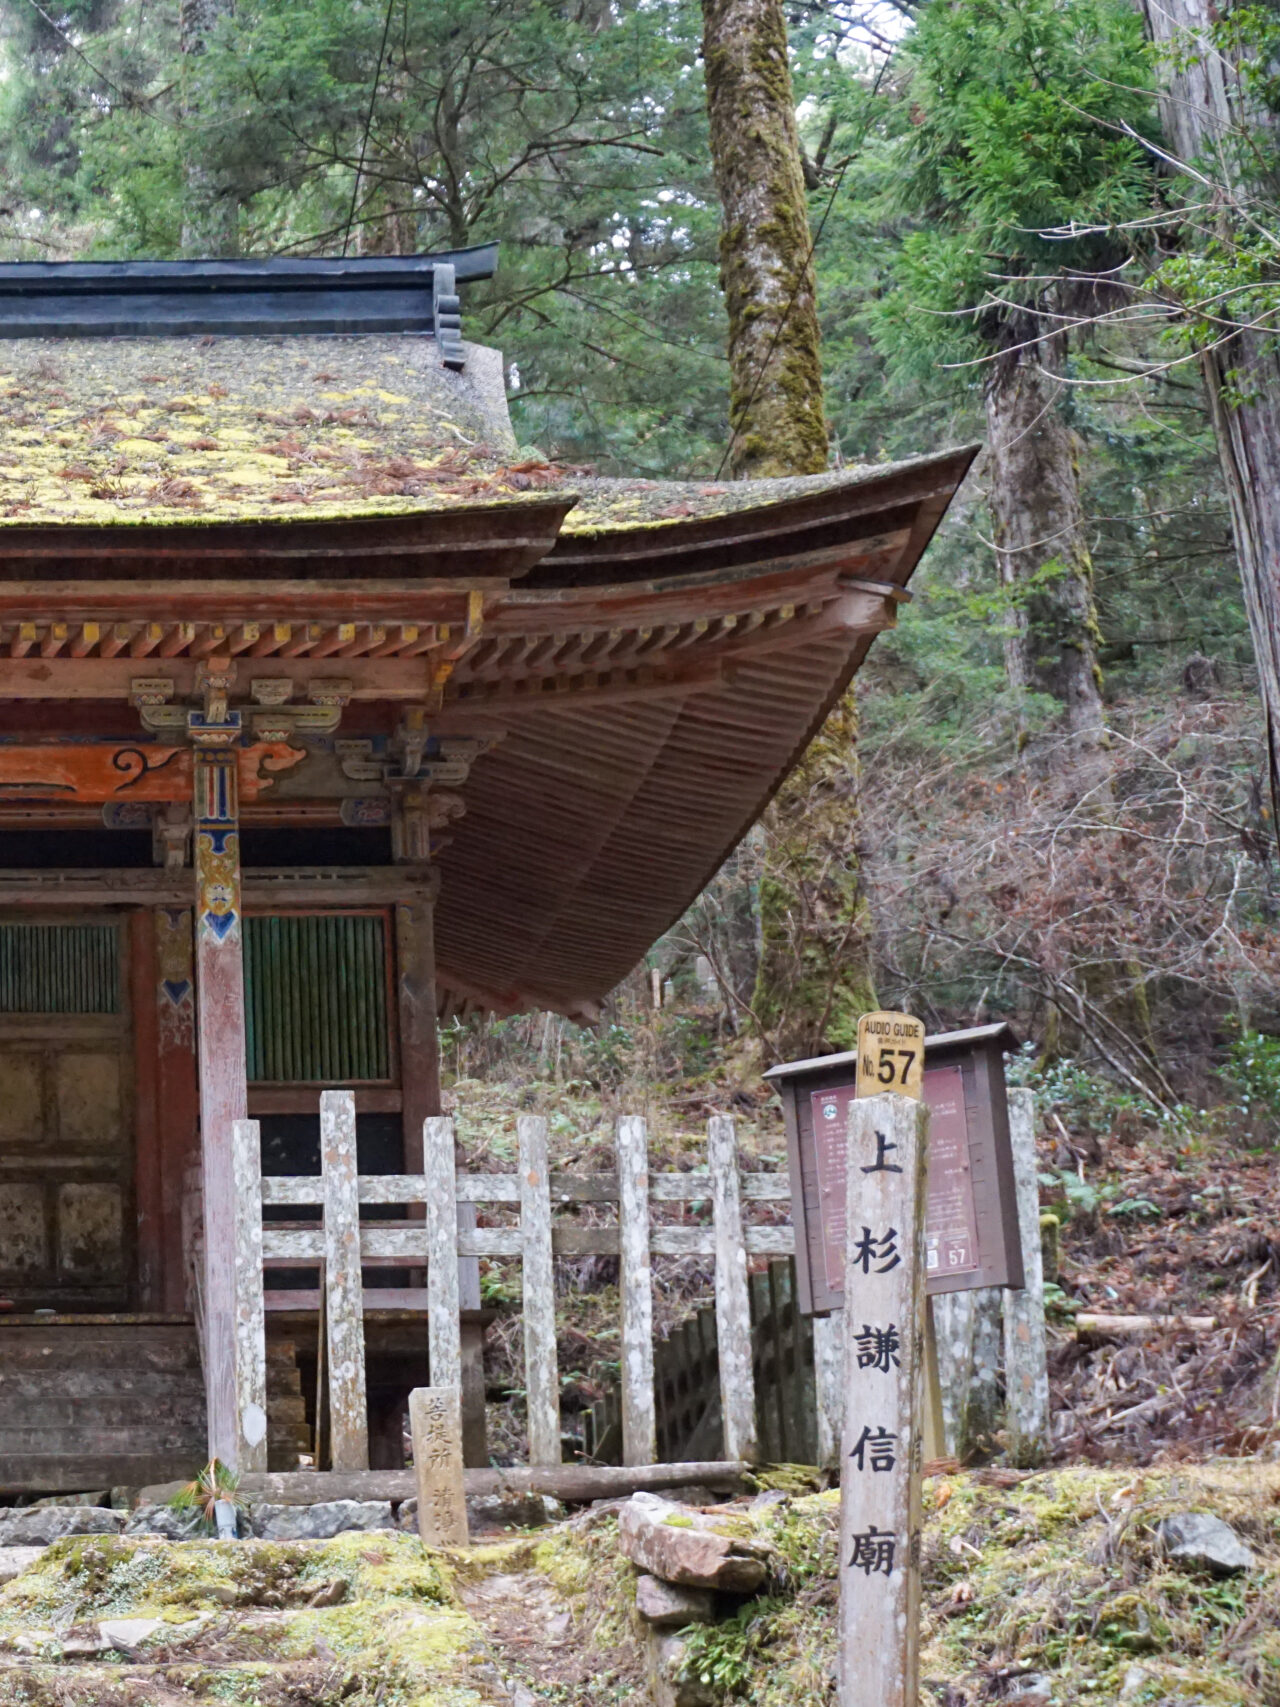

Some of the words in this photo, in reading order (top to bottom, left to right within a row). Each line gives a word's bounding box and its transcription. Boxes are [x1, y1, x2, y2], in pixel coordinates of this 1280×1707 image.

[864, 1020, 891, 1035] AUDIO
[893, 1023, 920, 1038] GUIDE
[862, 1054, 875, 1077] No.
[877, 1048, 916, 1085] 57
[948, 1248, 966, 1265] 57
[848, 1131, 902, 1577] 上杉謙信廟
